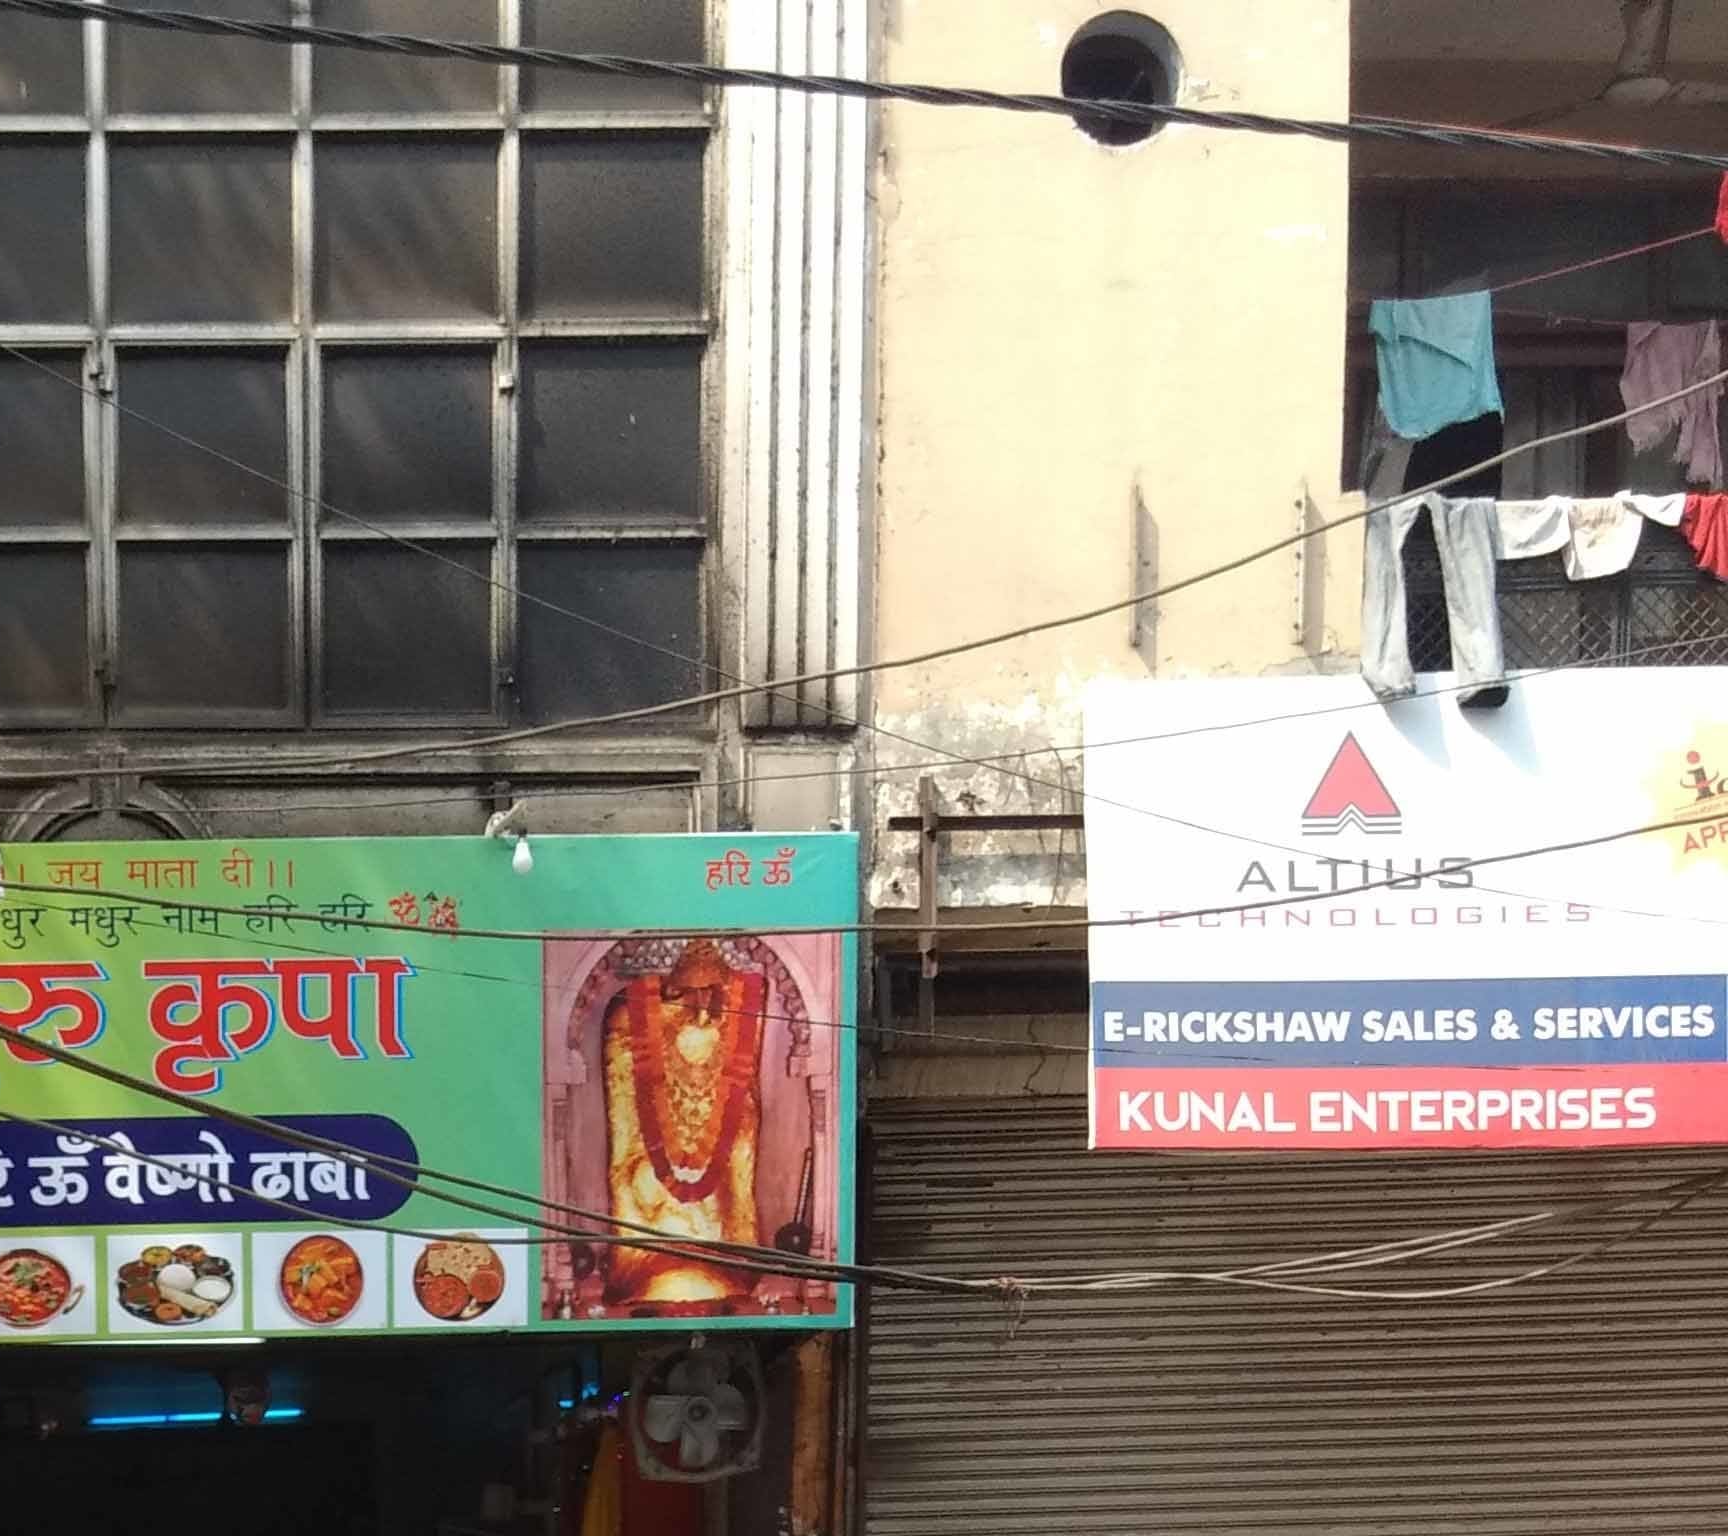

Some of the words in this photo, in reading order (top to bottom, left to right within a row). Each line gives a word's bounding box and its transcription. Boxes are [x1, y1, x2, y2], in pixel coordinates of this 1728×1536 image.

[48, 861, 103, 889] जय
[126, 860, 199, 888] माता
[221, 849, 254, 888] दी
[705, 849, 752, 891] हरि
[1237, 857, 1474, 893] ALTIUS
[67, 907, 140, 948] मधुर
[162, 904, 220, 934] नाम
[242, 895, 298, 934] हरि
[319, 893, 373, 933] हरि
[1119, 903, 1591, 928] TECHNOLOGIES
[142, 957, 418, 1095] कृपा
[1103, 1011, 1351, 1043] E-RICKSHAW
[1362, 1009, 1478, 1041] SALES
[1490, 1008, 1521, 1040] &
[1533, 1005, 1715, 1038] SERVICES
[1119, 1091, 1296, 1132] KUNAL
[1310, 1087, 1657, 1131] ENTERPRISES
[249, 1148, 373, 1202] ढाबा
